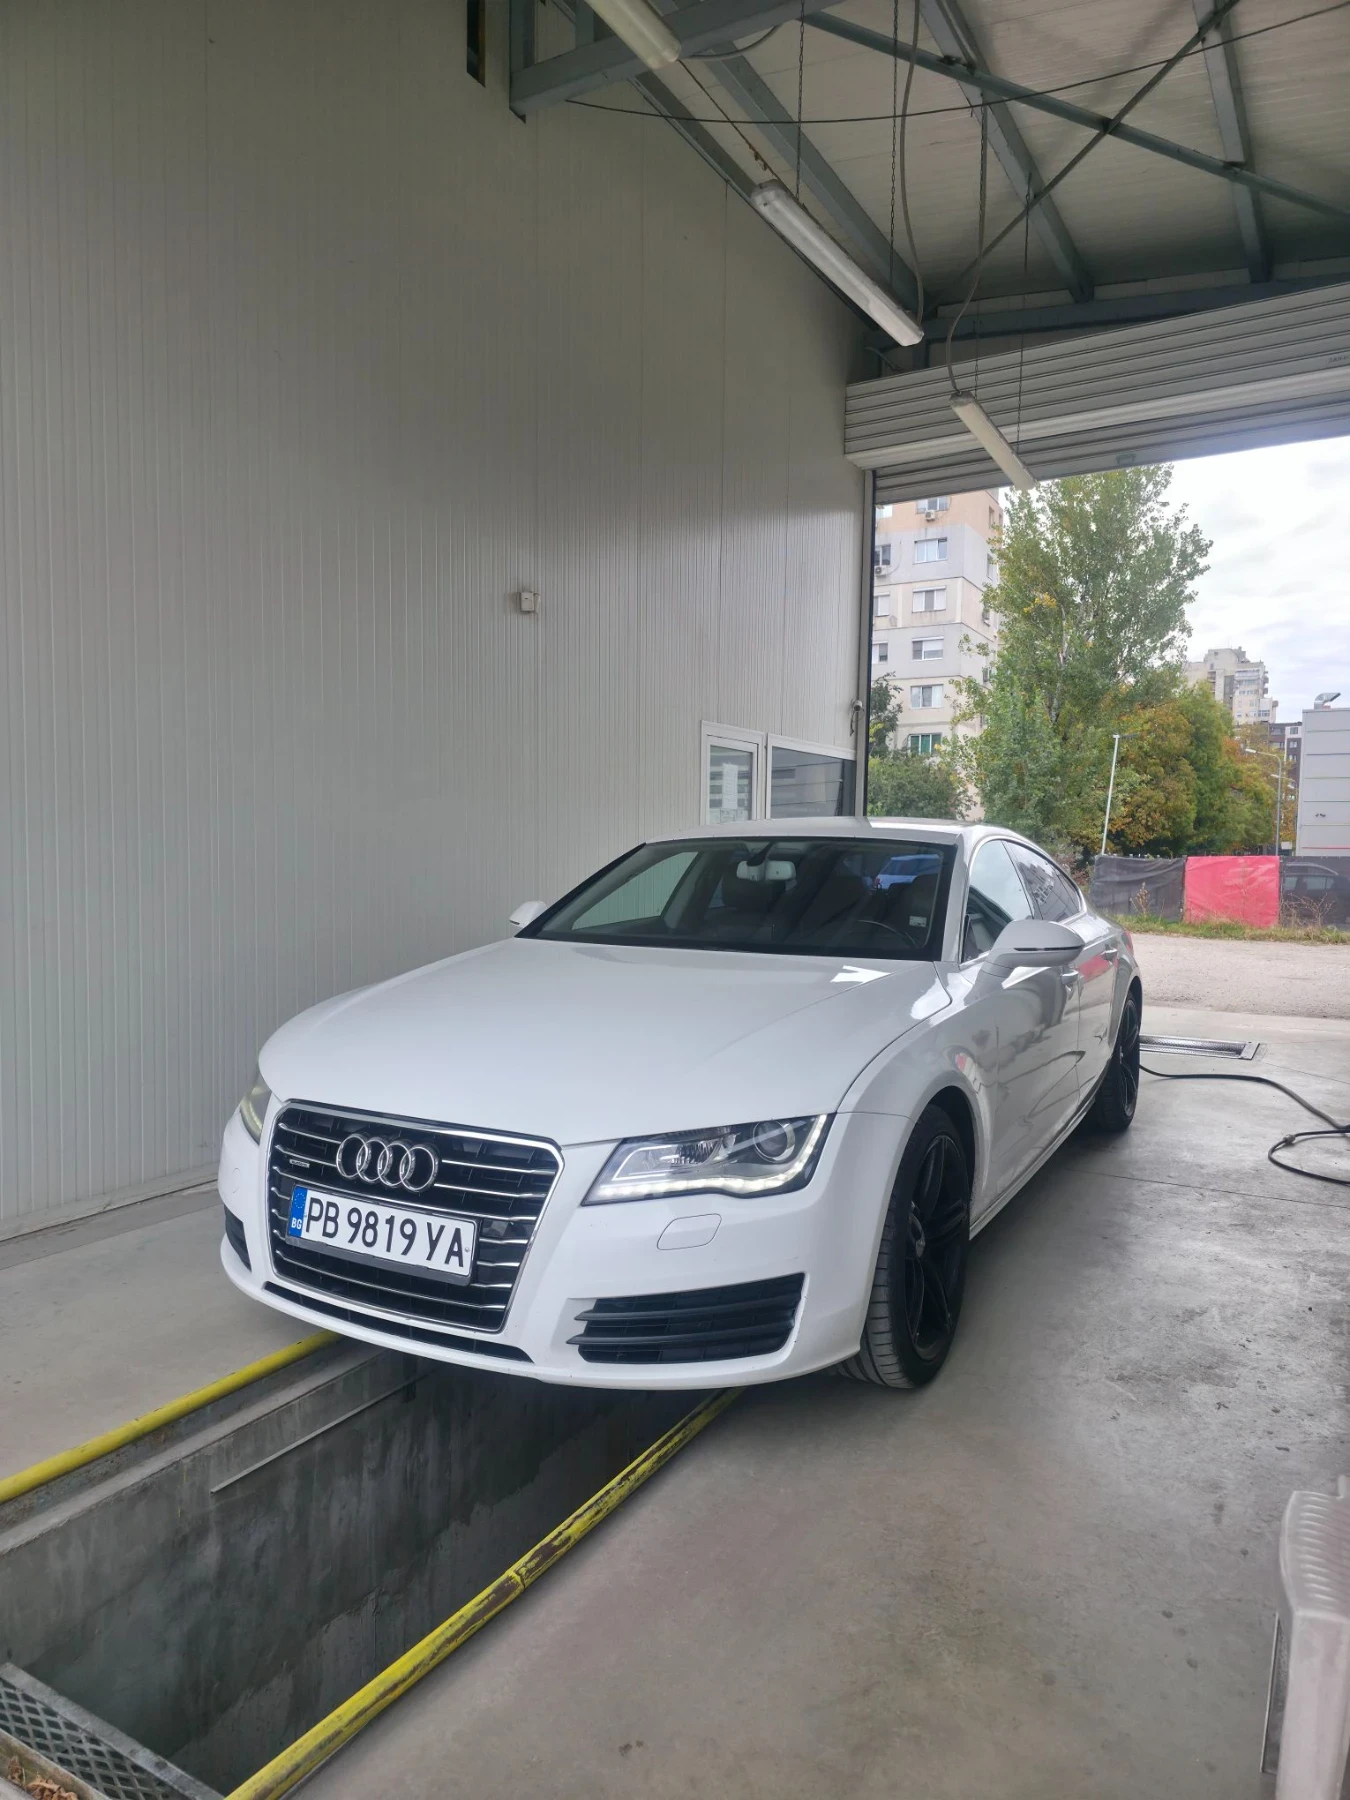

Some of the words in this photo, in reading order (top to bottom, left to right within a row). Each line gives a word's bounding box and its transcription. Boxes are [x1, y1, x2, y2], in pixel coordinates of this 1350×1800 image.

[291, 1217, 303, 1230] BG
[305, 1197, 340, 1239] PB
[347, 1207, 417, 1256] 9819
[426, 1221, 464, 1268] YA
